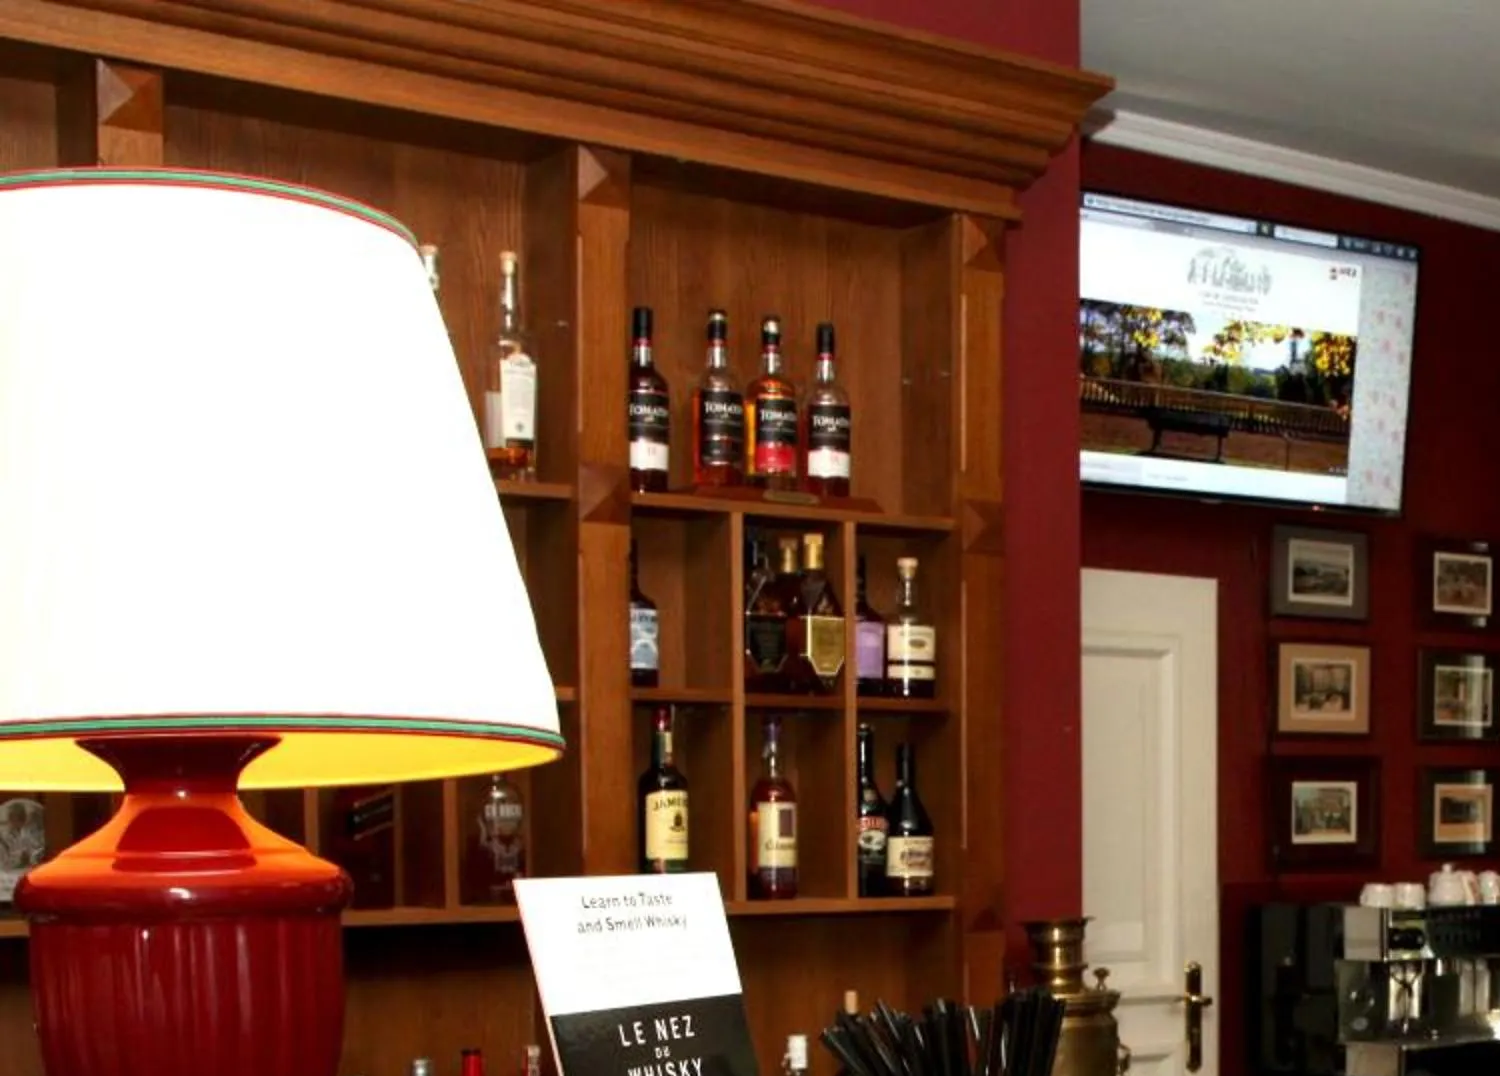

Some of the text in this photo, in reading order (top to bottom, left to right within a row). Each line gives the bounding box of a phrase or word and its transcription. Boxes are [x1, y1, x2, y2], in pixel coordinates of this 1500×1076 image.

[581, 891, 672, 909] Learn to Taste
[577, 914, 687, 934] and Smell Whisky
[618, 1014, 695, 1047] LE NEZ
